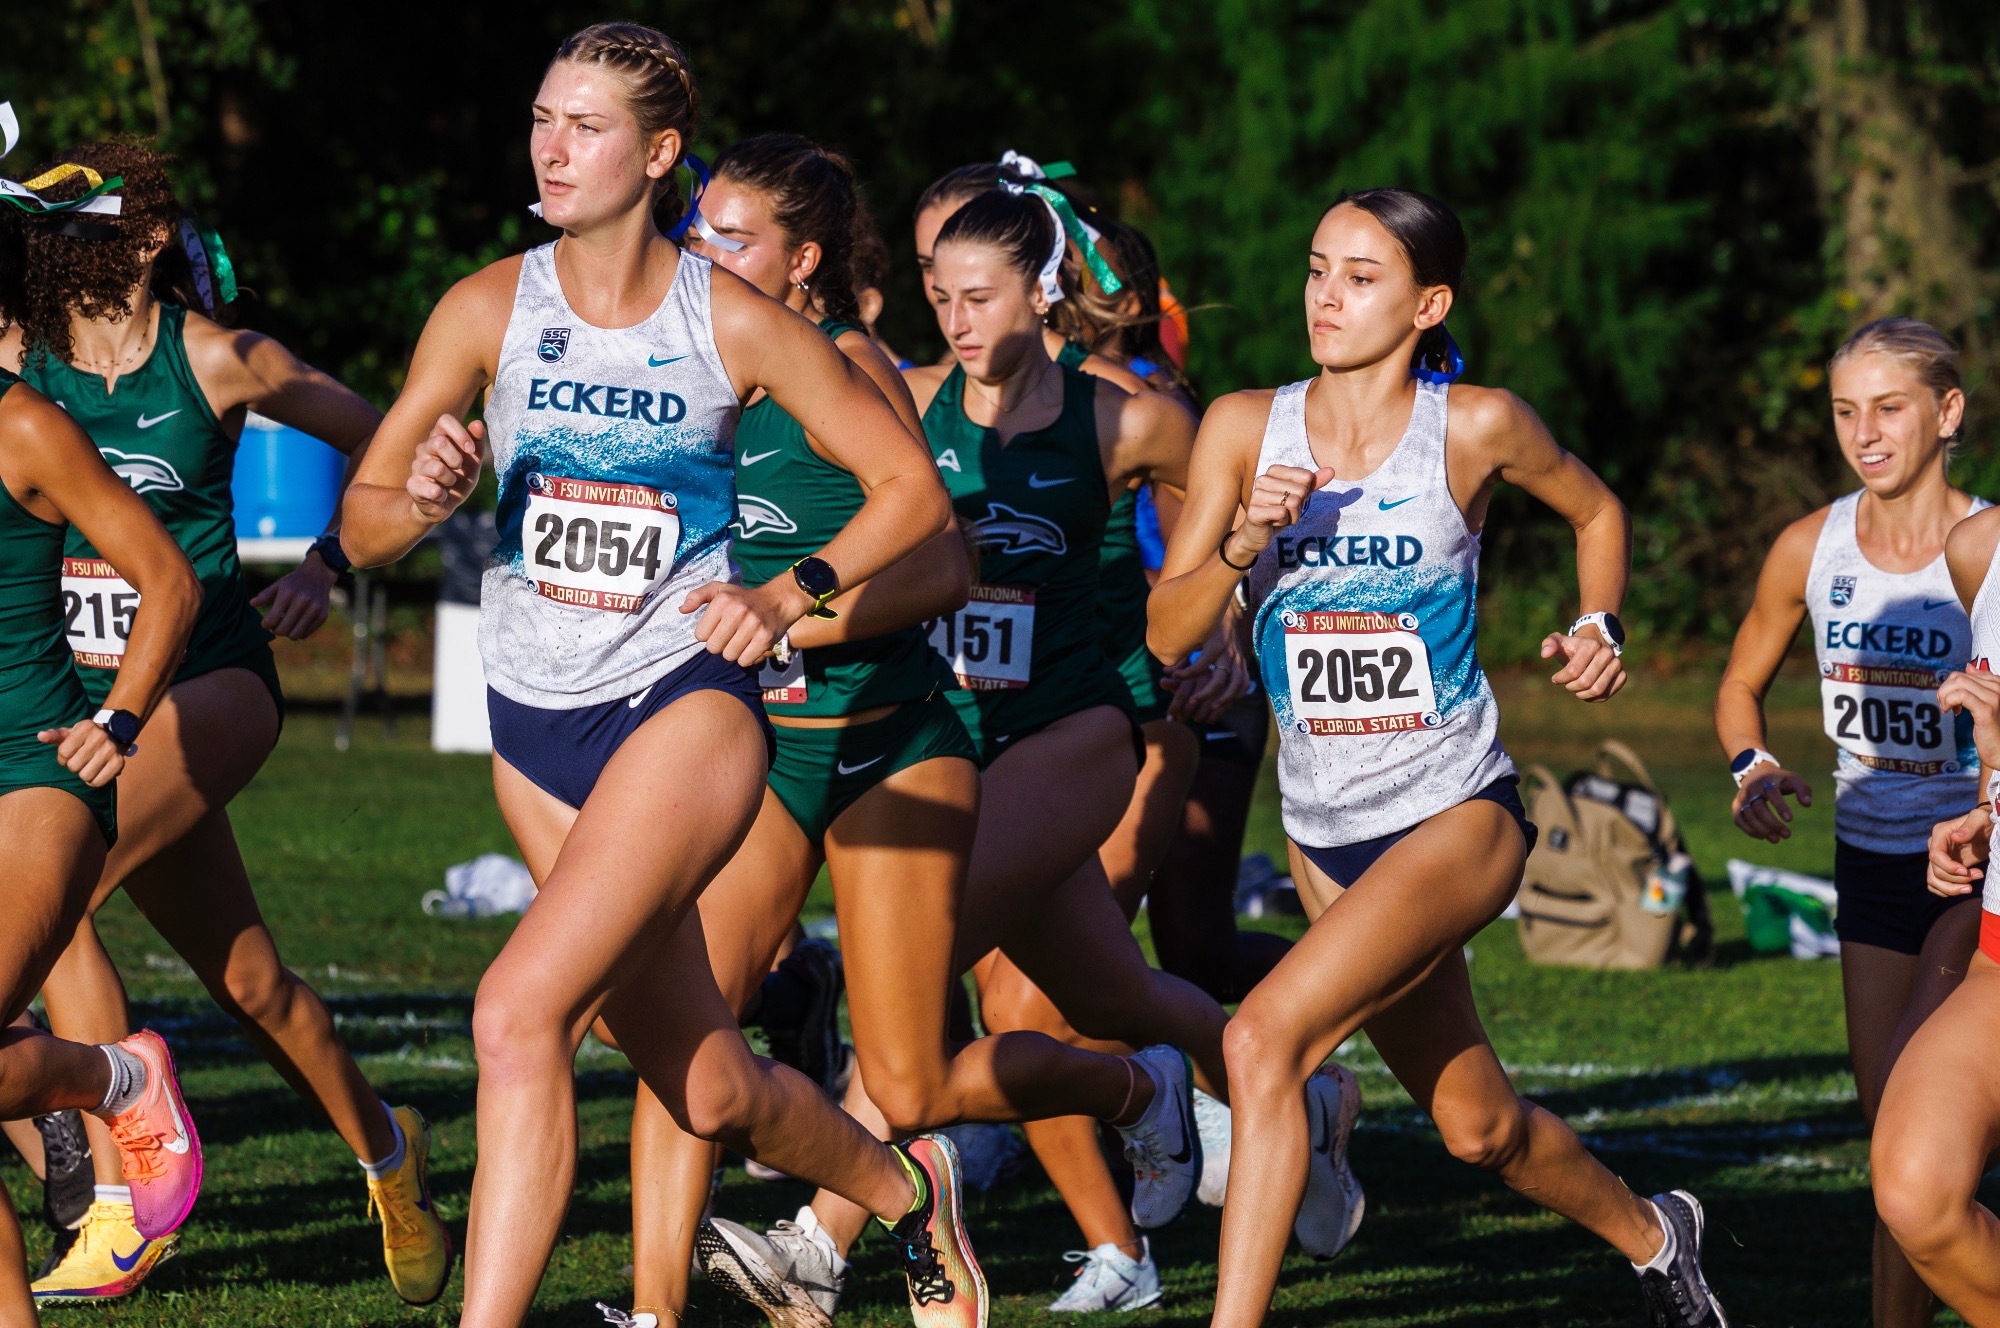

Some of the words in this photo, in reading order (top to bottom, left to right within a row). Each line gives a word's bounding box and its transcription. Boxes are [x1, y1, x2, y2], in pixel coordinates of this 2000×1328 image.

[544, 330, 568, 339] SSC
[527, 378, 687, 426] ECKERD
[560, 482, 582, 499] FSU
[584, 485, 667, 510] INVITATIONA
[535, 513, 662, 580] 2054
[1276, 535, 1423, 569] ECKERD
[72, 561, 91, 576] FSU
[1834, 577, 1855, 587] SSC
[544, 583, 598, 606] FLORIDA
[62, 590, 138, 641] 215
[1313, 616, 1334, 631] FSU
[1336, 615, 1401, 631] INVITATIONA
[1826, 621, 1952, 660] ECKERD
[74, 652, 120, 667] FLORIDA
[1298, 646, 1419, 704] 2052
[1848, 668, 1868, 682] FSU
[763, 688, 788, 701] TATE
[1313, 719, 1365, 733] FLORIDA
[1370, 715, 1415, 732] STATE
[1833, 694, 1943, 749] 2053
[1861, 755, 1896, 771] ORIDA
[1900, 761, 1937, 774] STATE
